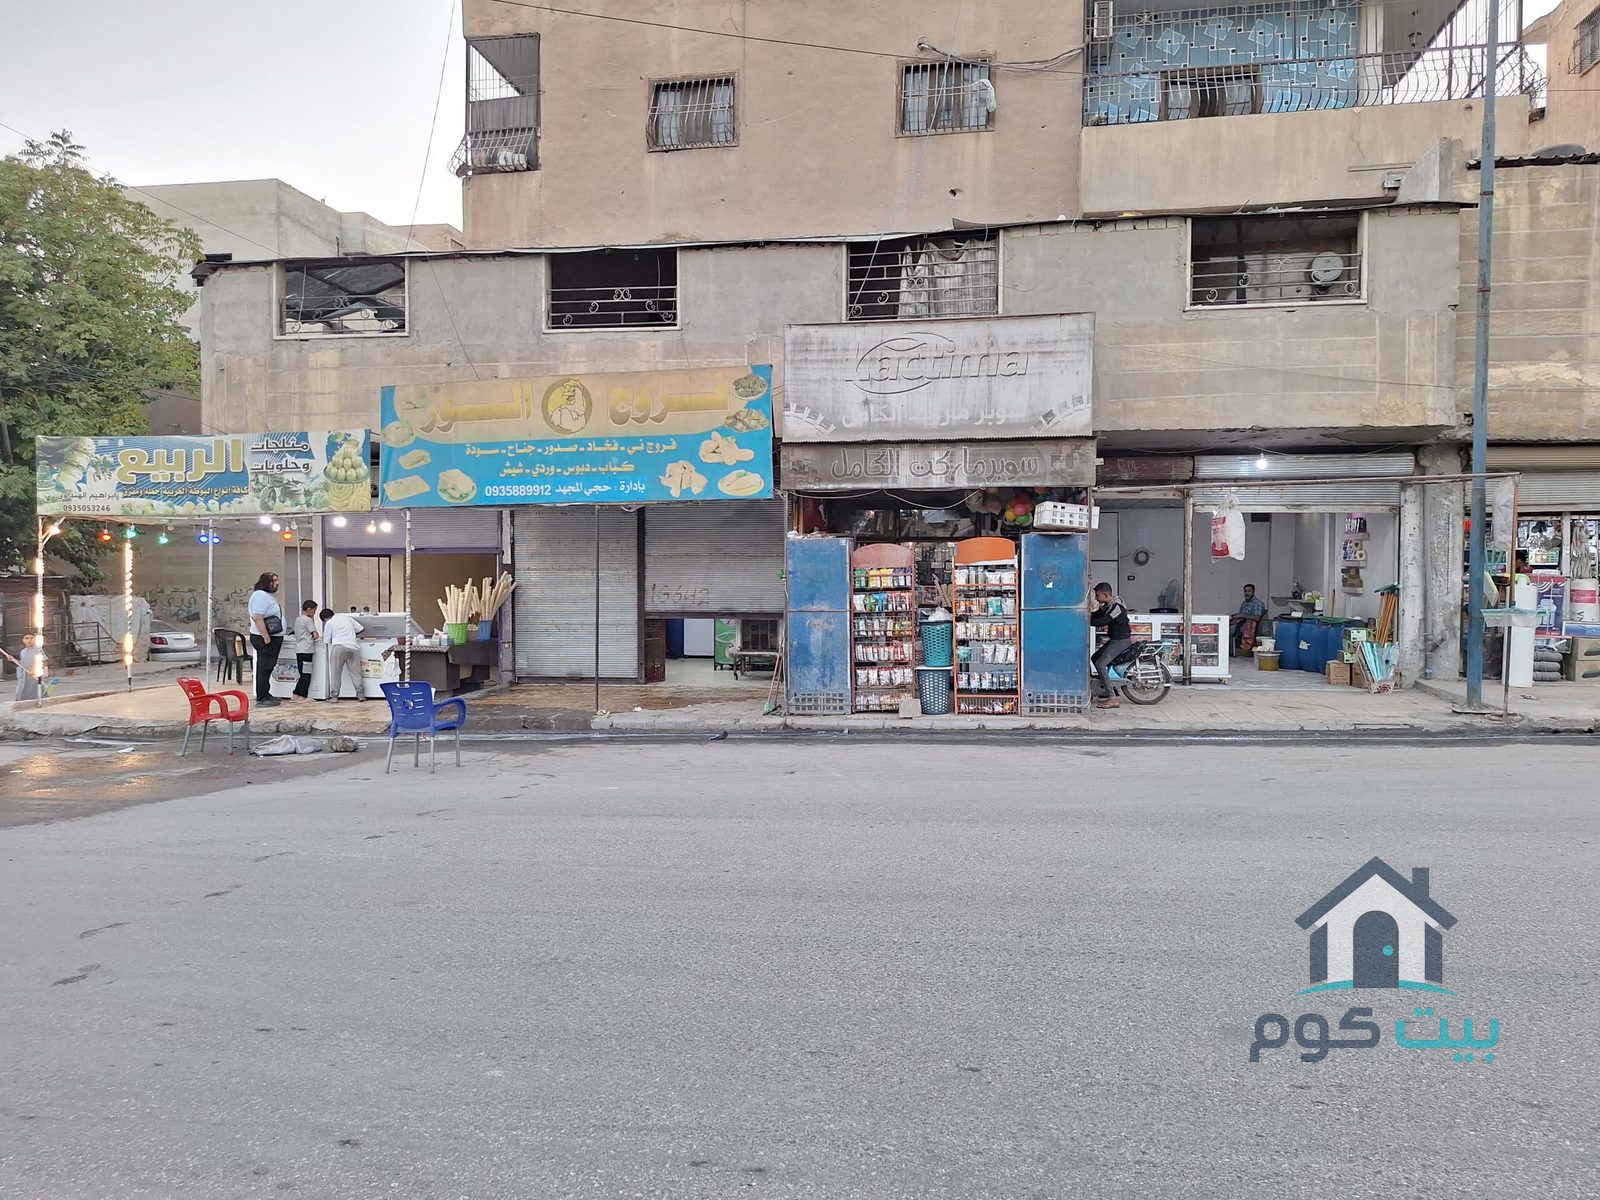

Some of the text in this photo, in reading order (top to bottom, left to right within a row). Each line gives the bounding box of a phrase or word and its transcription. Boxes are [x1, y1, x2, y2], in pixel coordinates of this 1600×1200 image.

[250, 437, 310, 453] مثلجات
[507, 442, 535, 457] جناح
[543, 442, 578, 455] صدور
[646, 438, 677, 454] فروج
[116, 438, 244, 484] الربيع
[250, 458, 311, 474] وحلويات
[598, 460, 635, 475] كباب
[830, 448, 901, 480] الكامل
[499, 461, 525, 477] شيش
[531, 463, 555, 477] وردي
[485, 484, 552, 497] 0935889912
[63, 504, 111, 512] 0935053246
